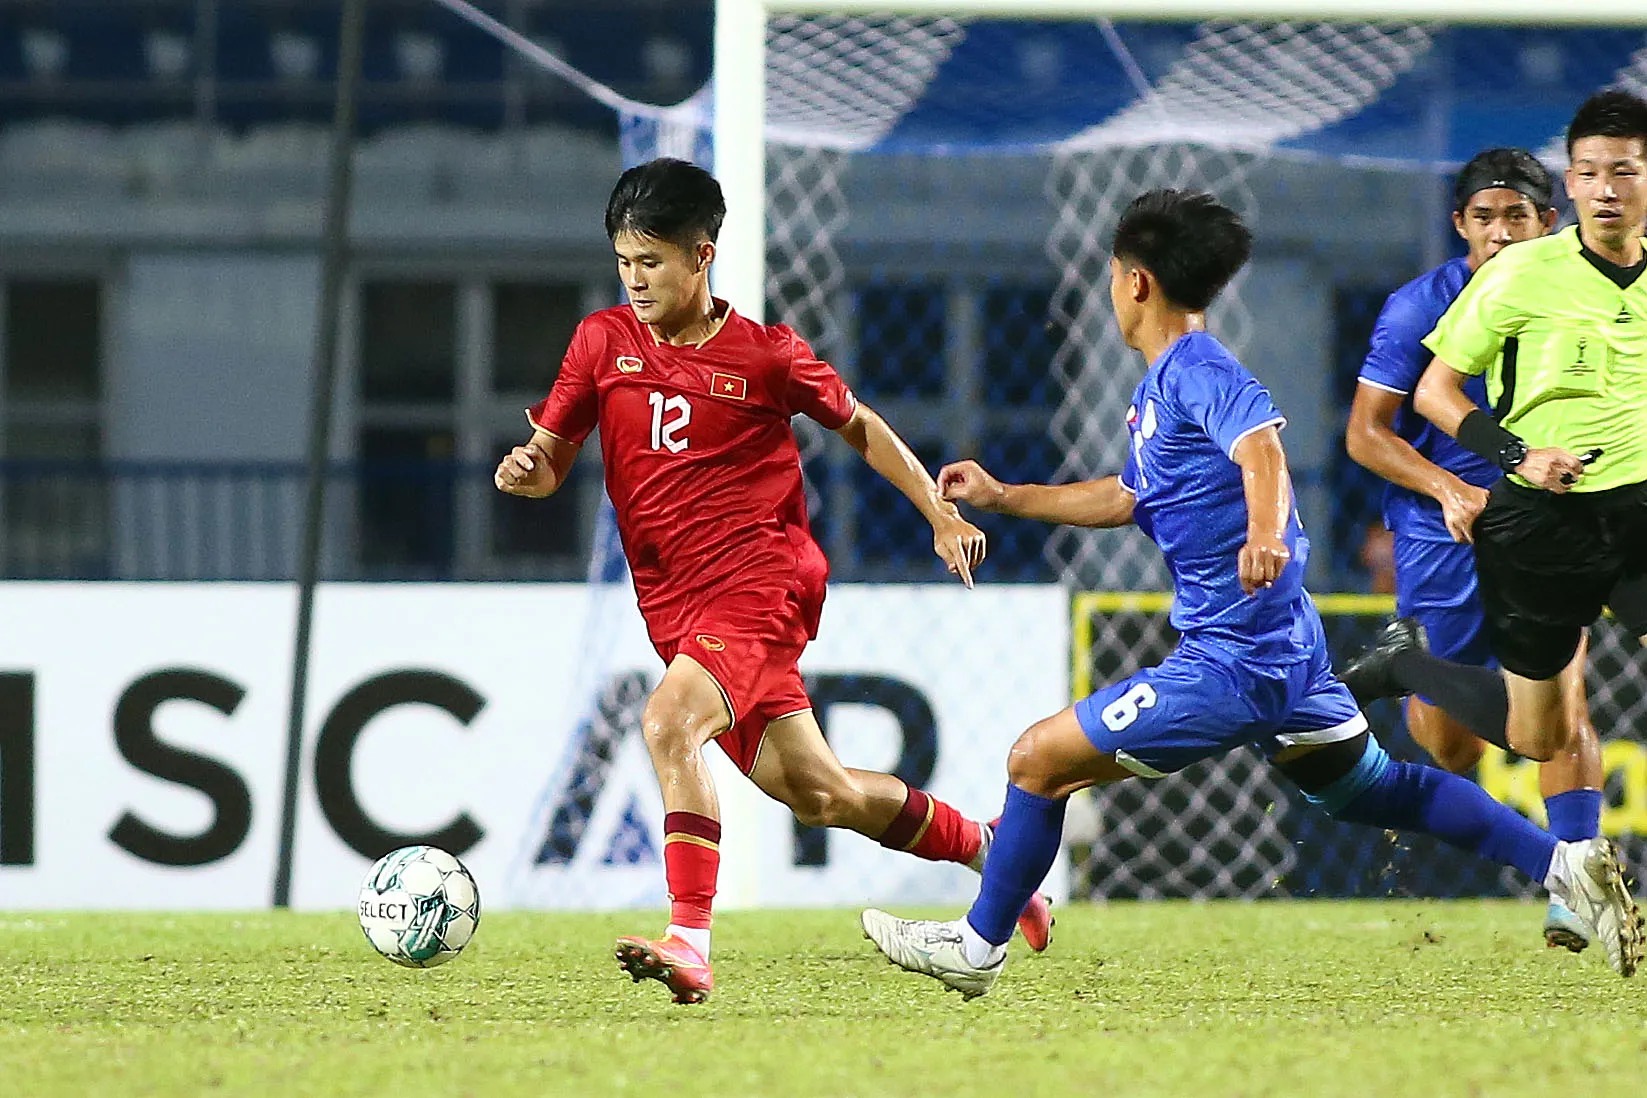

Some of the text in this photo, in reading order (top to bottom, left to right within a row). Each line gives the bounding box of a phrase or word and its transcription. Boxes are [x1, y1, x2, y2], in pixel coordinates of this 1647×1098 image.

[648, 391, 692, 454] 12
[1101, 682, 1158, 733] 6
[359, 900, 408, 921] SELECT
